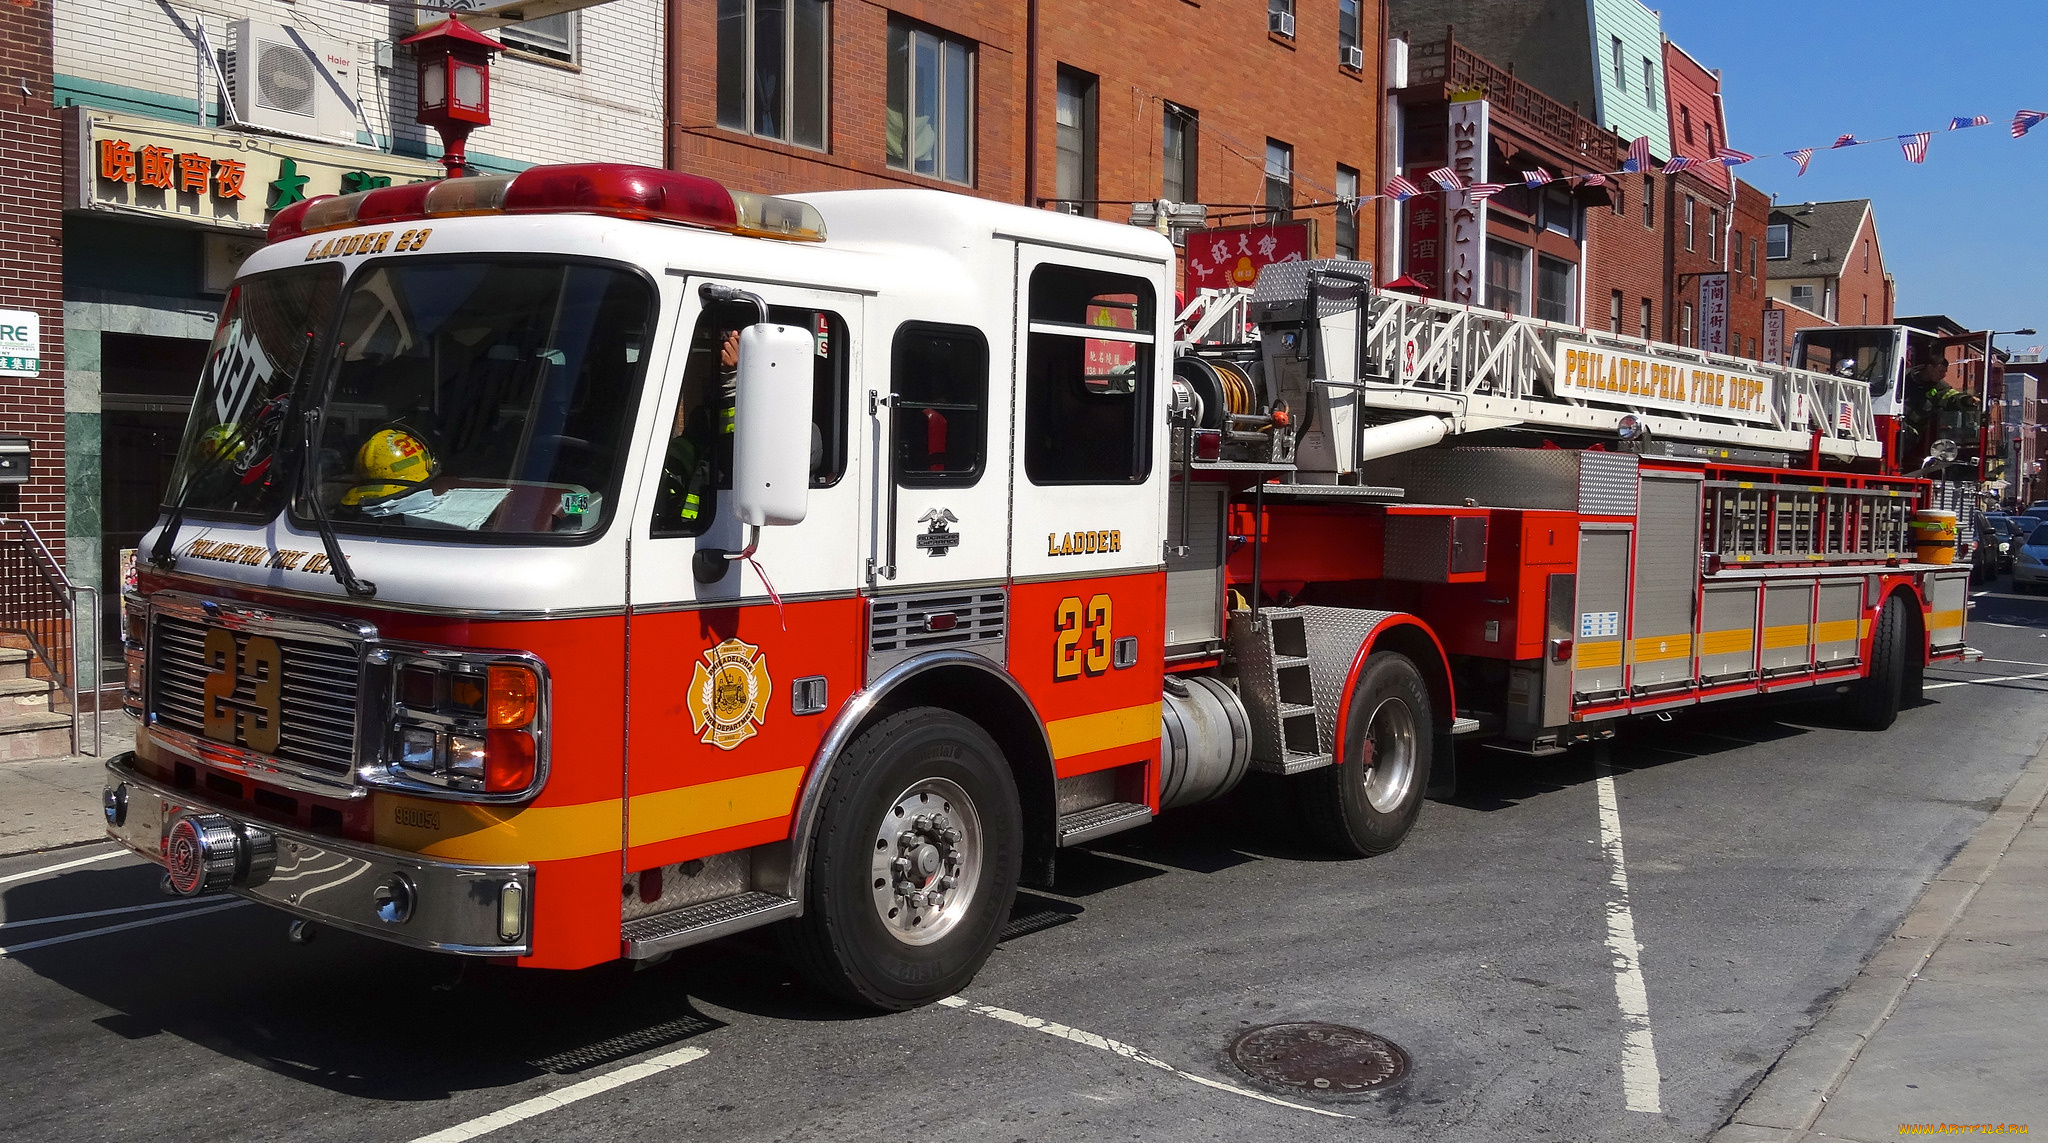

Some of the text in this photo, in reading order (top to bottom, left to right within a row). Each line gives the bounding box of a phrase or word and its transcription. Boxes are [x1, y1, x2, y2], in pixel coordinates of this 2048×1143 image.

[327, 54, 350, 67] Haier
[101, 139, 247, 200] 晚飯宵夜
[305, 228, 432, 262] LADDER 23
[1564, 348, 1765, 414] PHILADELPHIA FIRE DEPT.
[184, 538, 268, 567] PHILADELPHIA
[264, 549, 309, 571] FIRE
[1048, 529, 1121, 557] LADDER
[1053, 593, 1113, 684] 23
[1582, 613, 1617, 636] RIT
[708, 655, 753, 677] PHILADELPHIA
[203, 627, 281, 754] 23
[703, 703, 757, 732] FIRE DEPARTMENT
[394, 806, 440, 830] 980054
